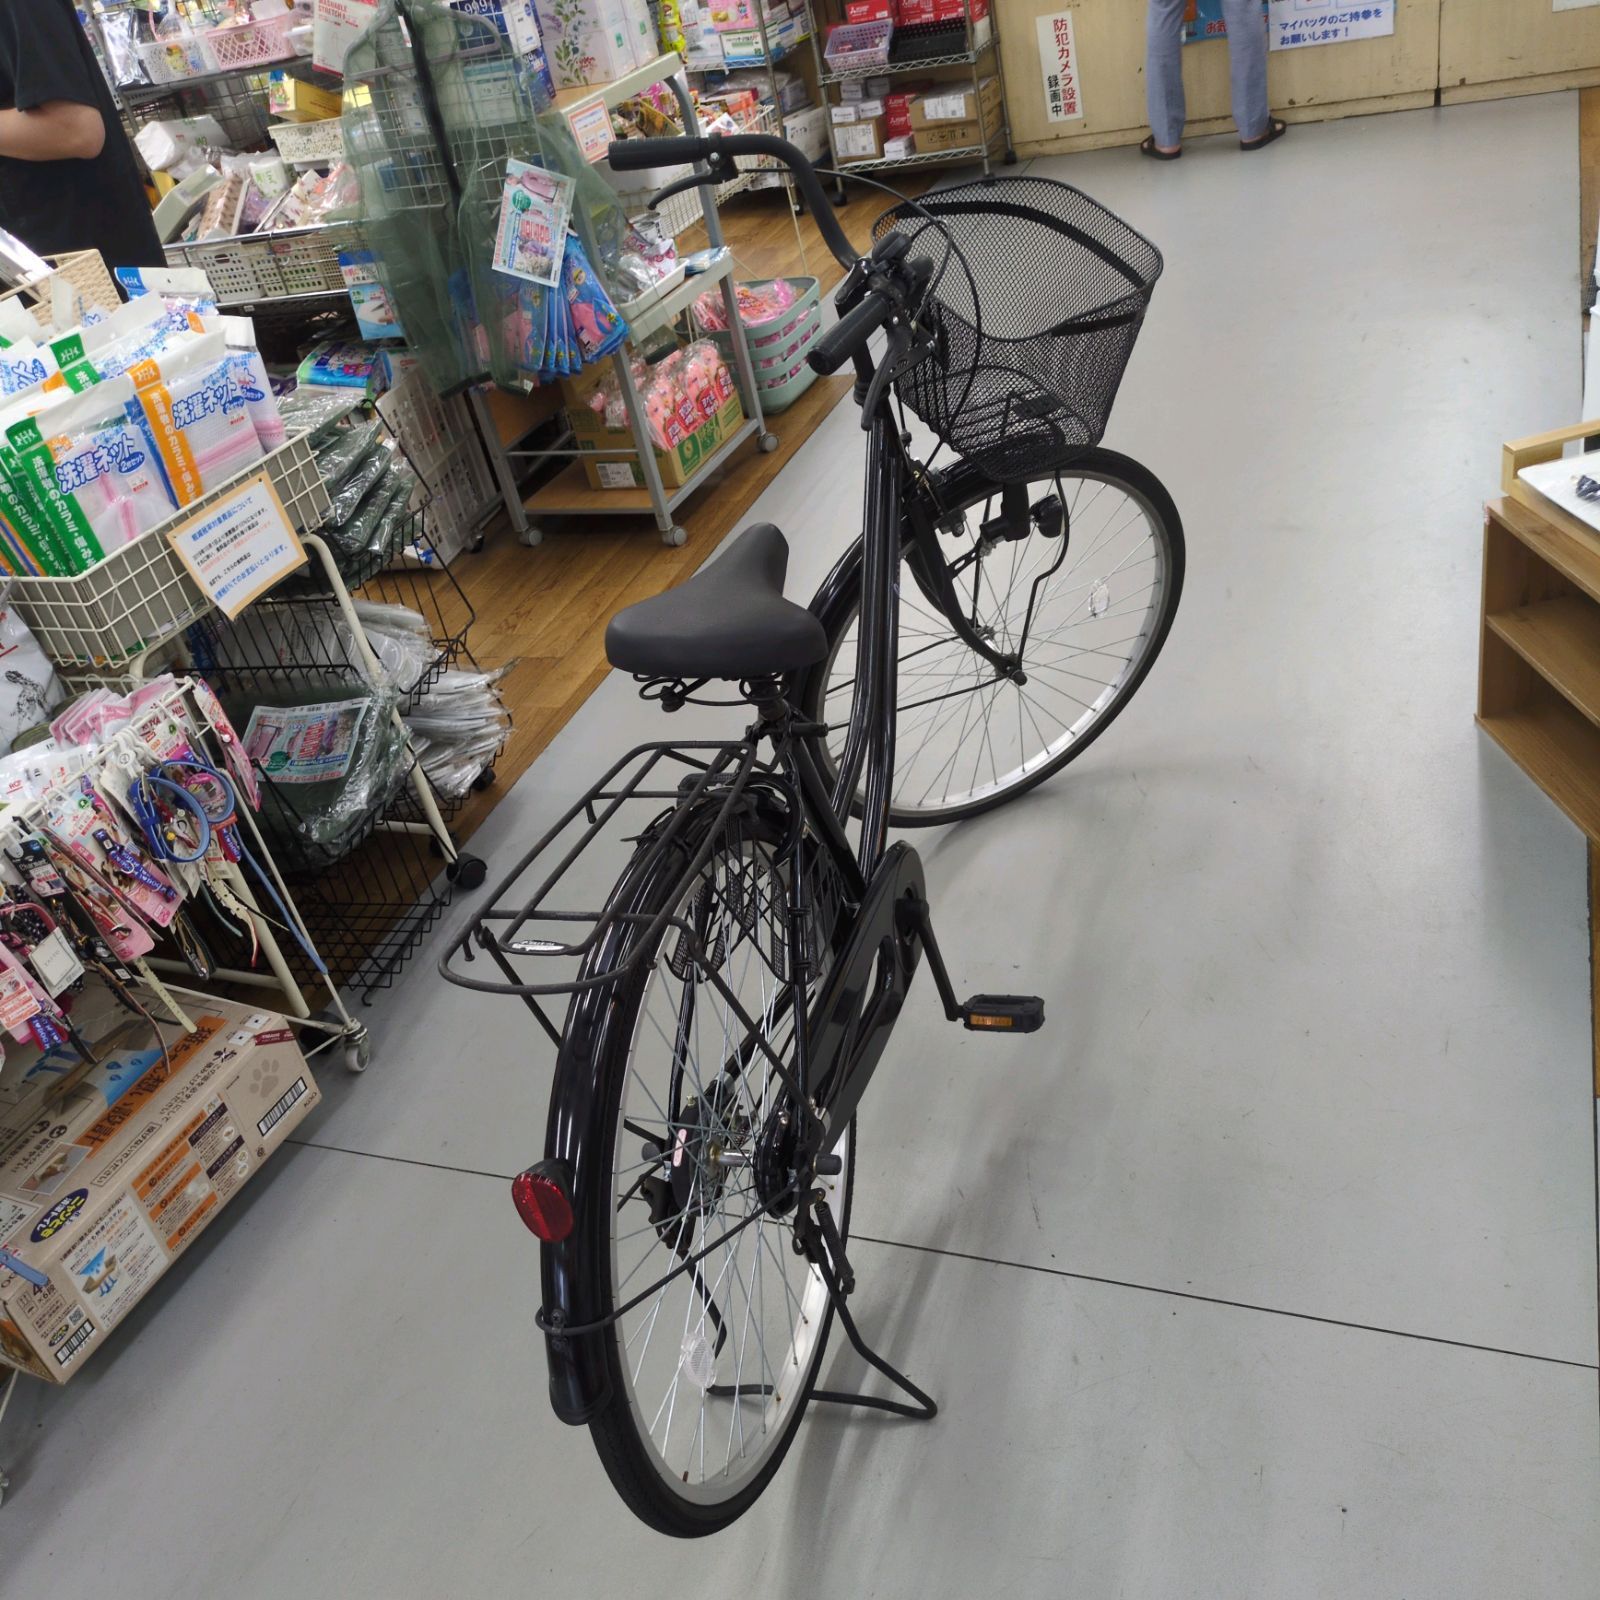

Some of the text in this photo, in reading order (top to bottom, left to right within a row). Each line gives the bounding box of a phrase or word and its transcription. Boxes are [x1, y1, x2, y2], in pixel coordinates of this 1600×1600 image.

[1206, 17, 1226, 34] お気
[1279, 8, 1383, 31] マイバッグのご持参を
[1053, 18, 1078, 116] 防犯カメラ設置
[1047, 74, 1062, 117] 録画中
[172, 376, 238, 430] 洗濯ネット
[55, 432, 136, 494] 洗濯ネット
[96, 1124, 157, 1184] 投げないでください
[40, 1195, 86, 1239] ニャンとも
